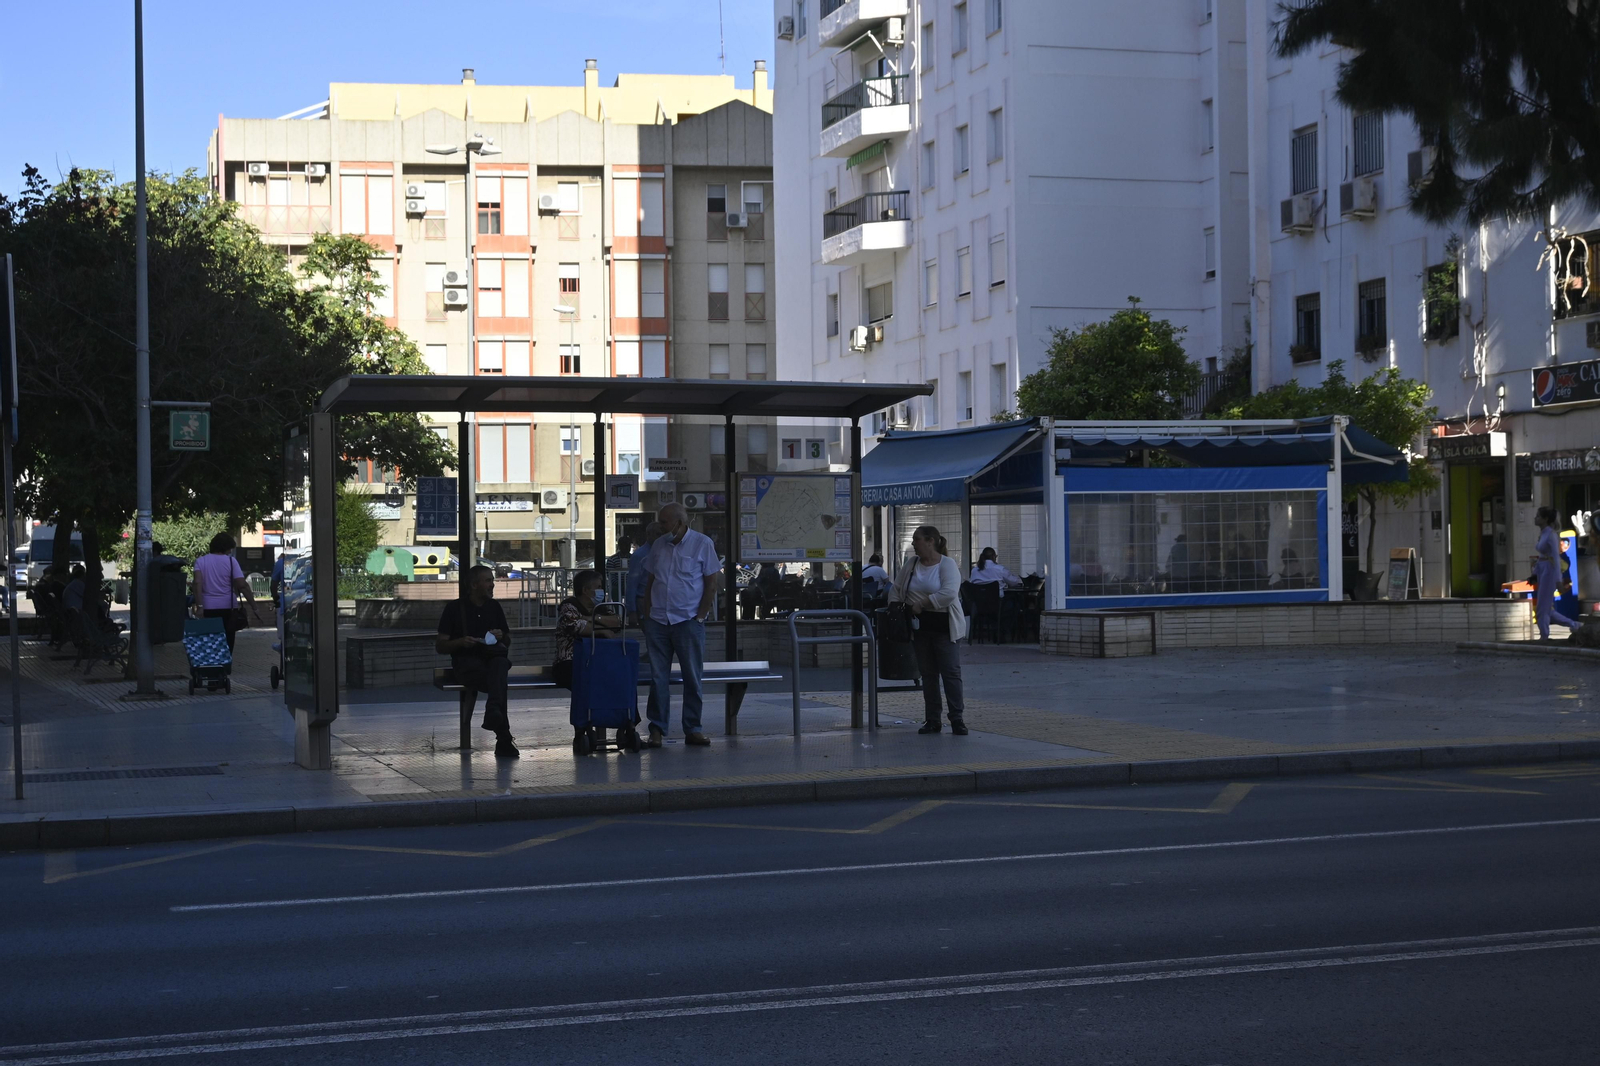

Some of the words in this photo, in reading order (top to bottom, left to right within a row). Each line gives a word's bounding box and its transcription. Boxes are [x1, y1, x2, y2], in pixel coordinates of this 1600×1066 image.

[787, 443, 794, 458] 1
[811, 442, 820, 458] 3
[1444, 446, 1461, 458] ISLA
[1462, 445, 1487, 456] CHICA
[1533, 454, 1583, 472] CHURRERÍA
[883, 487, 902, 501] CASA
[903, 484, 934, 500] ANTONIO
[1348, 536, 1355, 547] €
